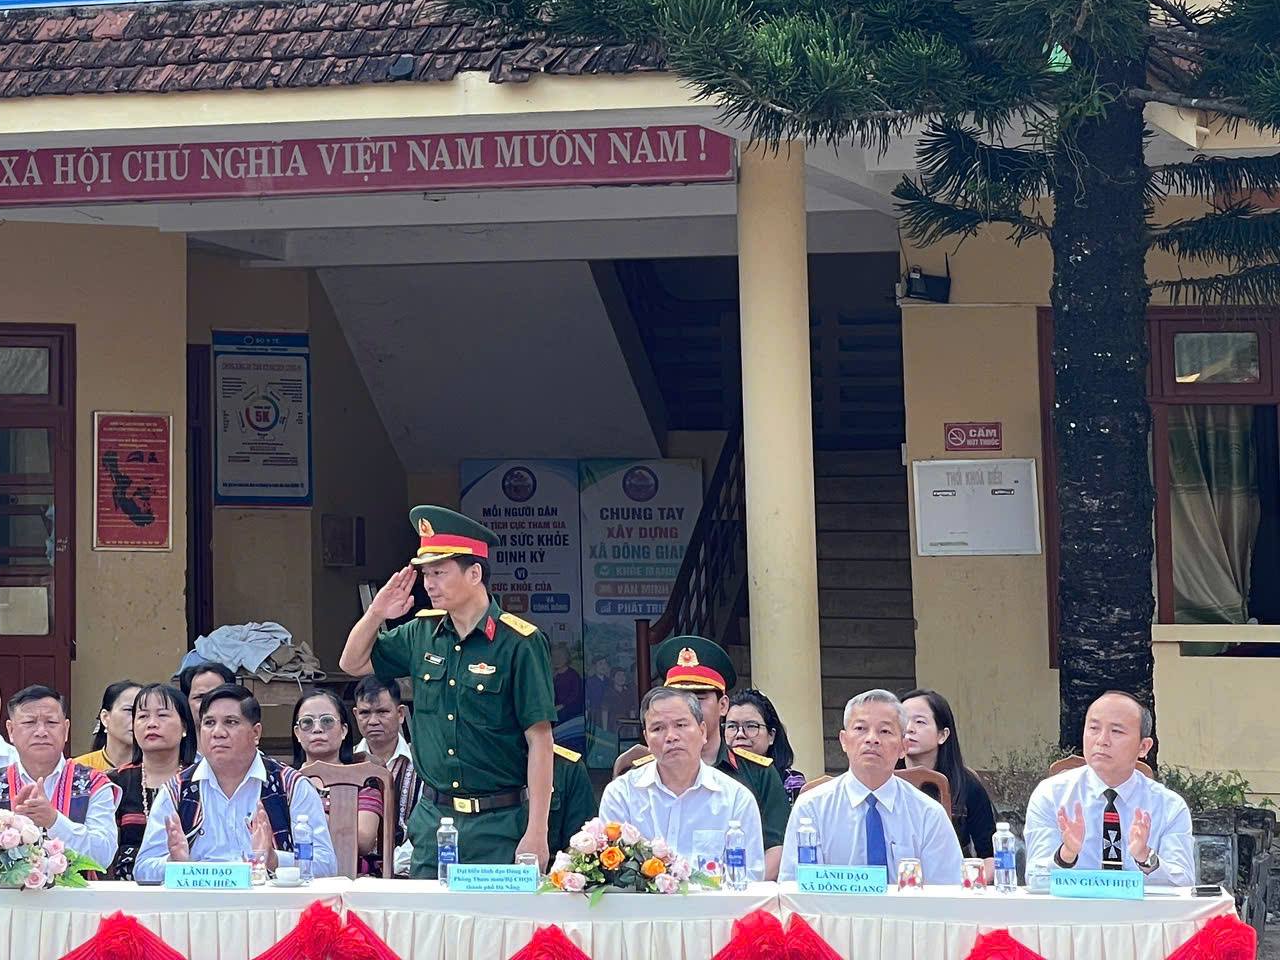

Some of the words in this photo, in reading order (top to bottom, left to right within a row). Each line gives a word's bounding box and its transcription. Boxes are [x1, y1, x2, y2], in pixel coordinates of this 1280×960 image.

[0, 145, 43, 187] XÃ
[53, 146, 112, 192] HỘI
[122, 143, 191, 183] CHỦ
[201, 139, 308, 181] NGHĨA
[317, 135, 397, 182] VIỆT
[406, 137, 488, 171] NAM
[494, 130, 599, 168] MUÔN
[607, 126, 689, 164] NĂM
[255, 410, 271, 422] 5K
[969, 426, 997, 438] CẤM
[600, 507, 653, 520] CHUNG
[657, 507, 685, 520] TAY
[606, 524, 633, 539] XÂY
[639, 526, 679, 540] DỰNG
[510, 532, 534, 547] SỨC
[537, 531, 570, 547] KHỎE
[496, 550, 526, 566] ĐỊNH
[849, 883, 884, 894] GIANG
[1055, 877, 1077, 886] BAN
[1080, 877, 1109, 887] GIÁM
